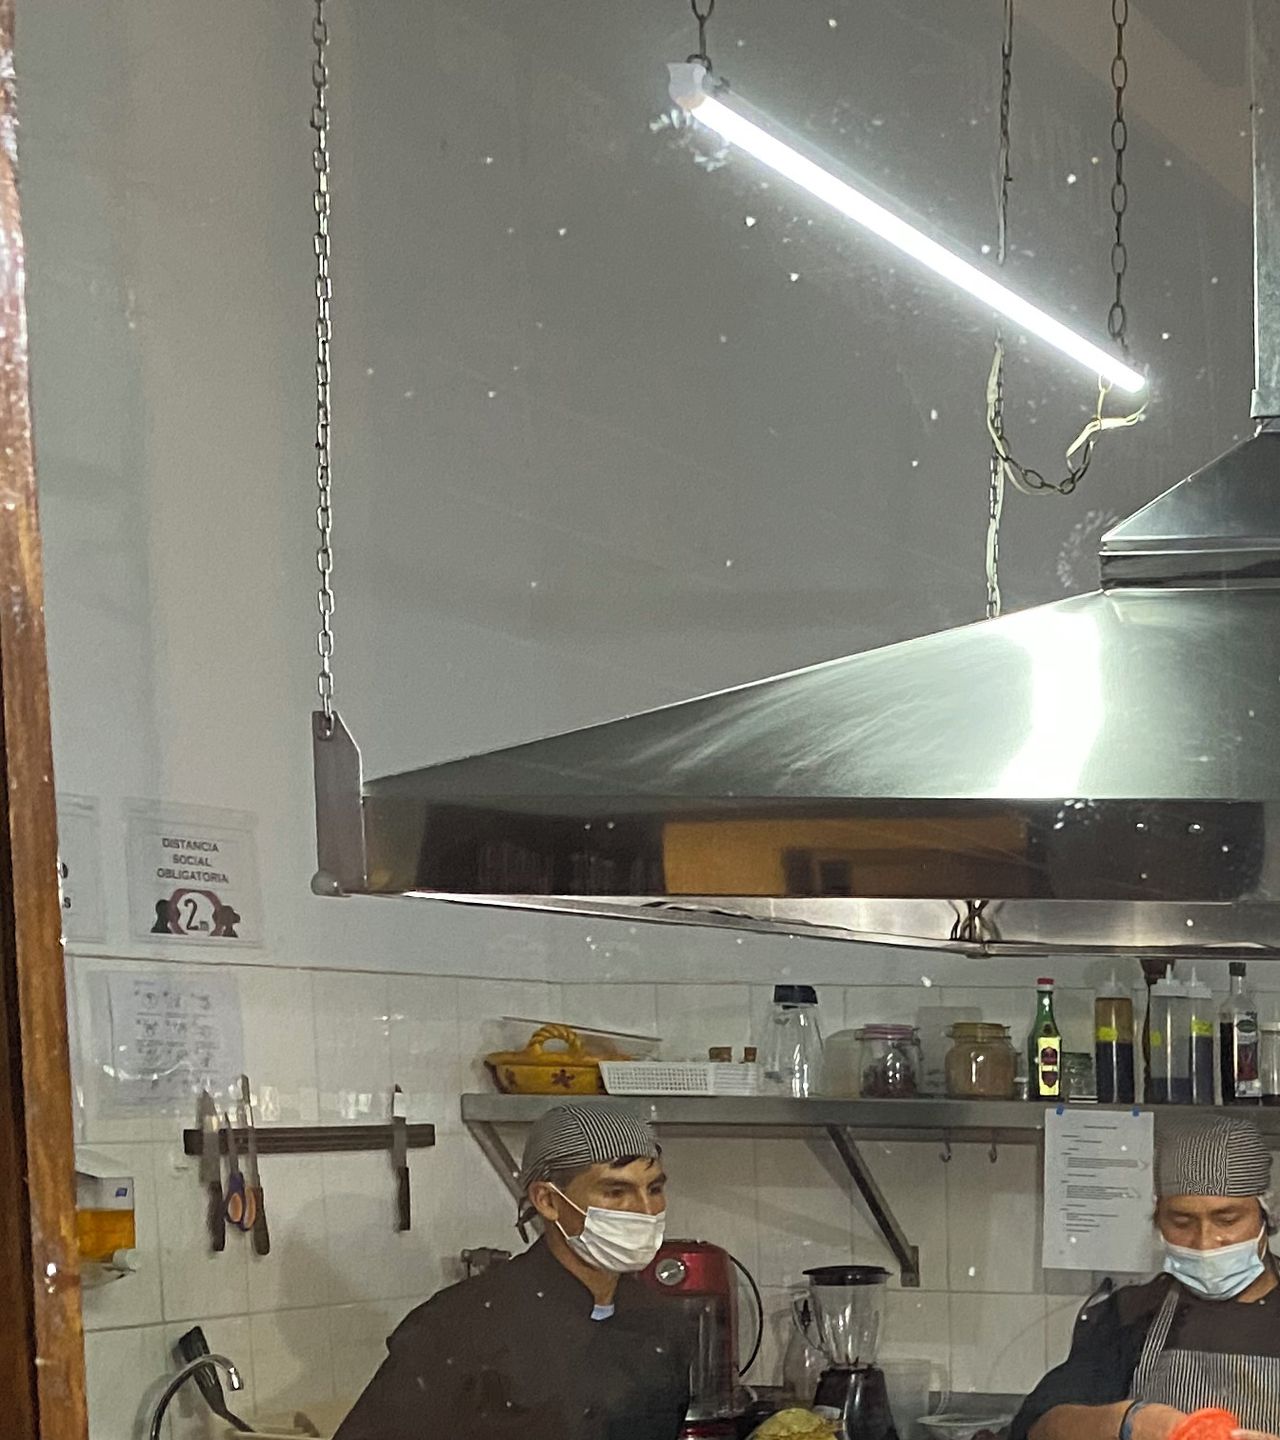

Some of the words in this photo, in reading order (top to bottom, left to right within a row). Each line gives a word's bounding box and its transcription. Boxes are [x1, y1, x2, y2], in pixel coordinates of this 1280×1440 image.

[162, 838, 219, 852] DISTANCIA
[173, 854, 212, 867] SOCIAL
[157, 868, 229, 883] OBLIGATORIA
